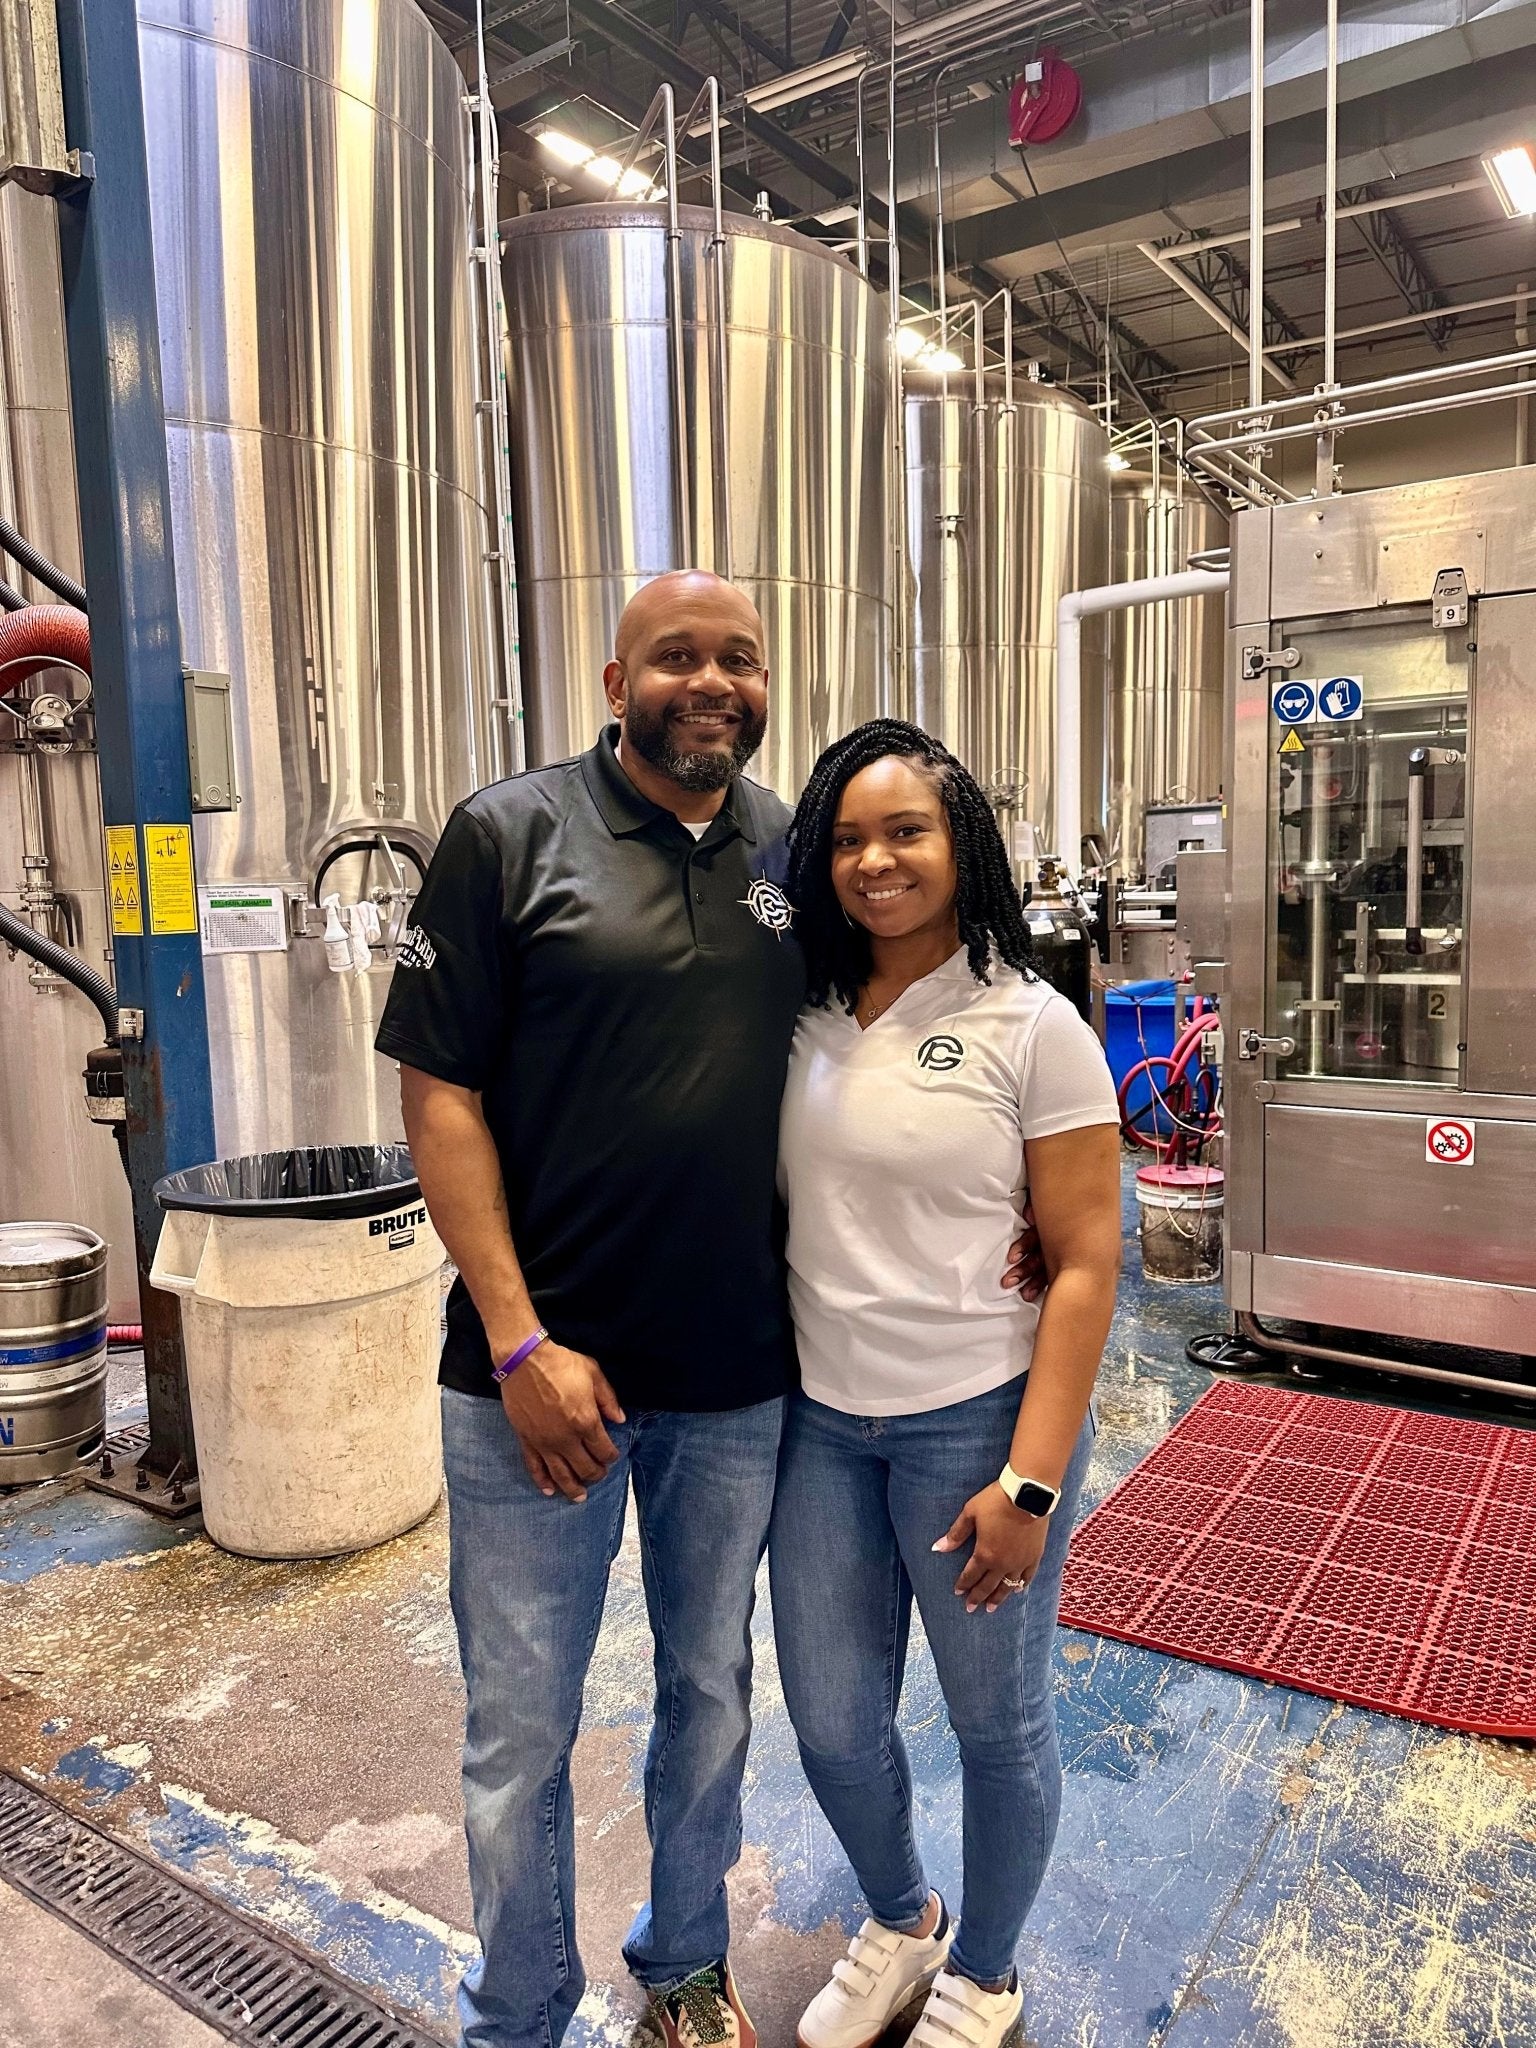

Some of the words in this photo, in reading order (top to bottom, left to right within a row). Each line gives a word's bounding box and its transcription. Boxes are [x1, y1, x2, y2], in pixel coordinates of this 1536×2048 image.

[1446, 608, 1455, 620] 9
[1430, 993, 1446, 1016] 2
[368, 1206, 426, 1237] BRUTE
